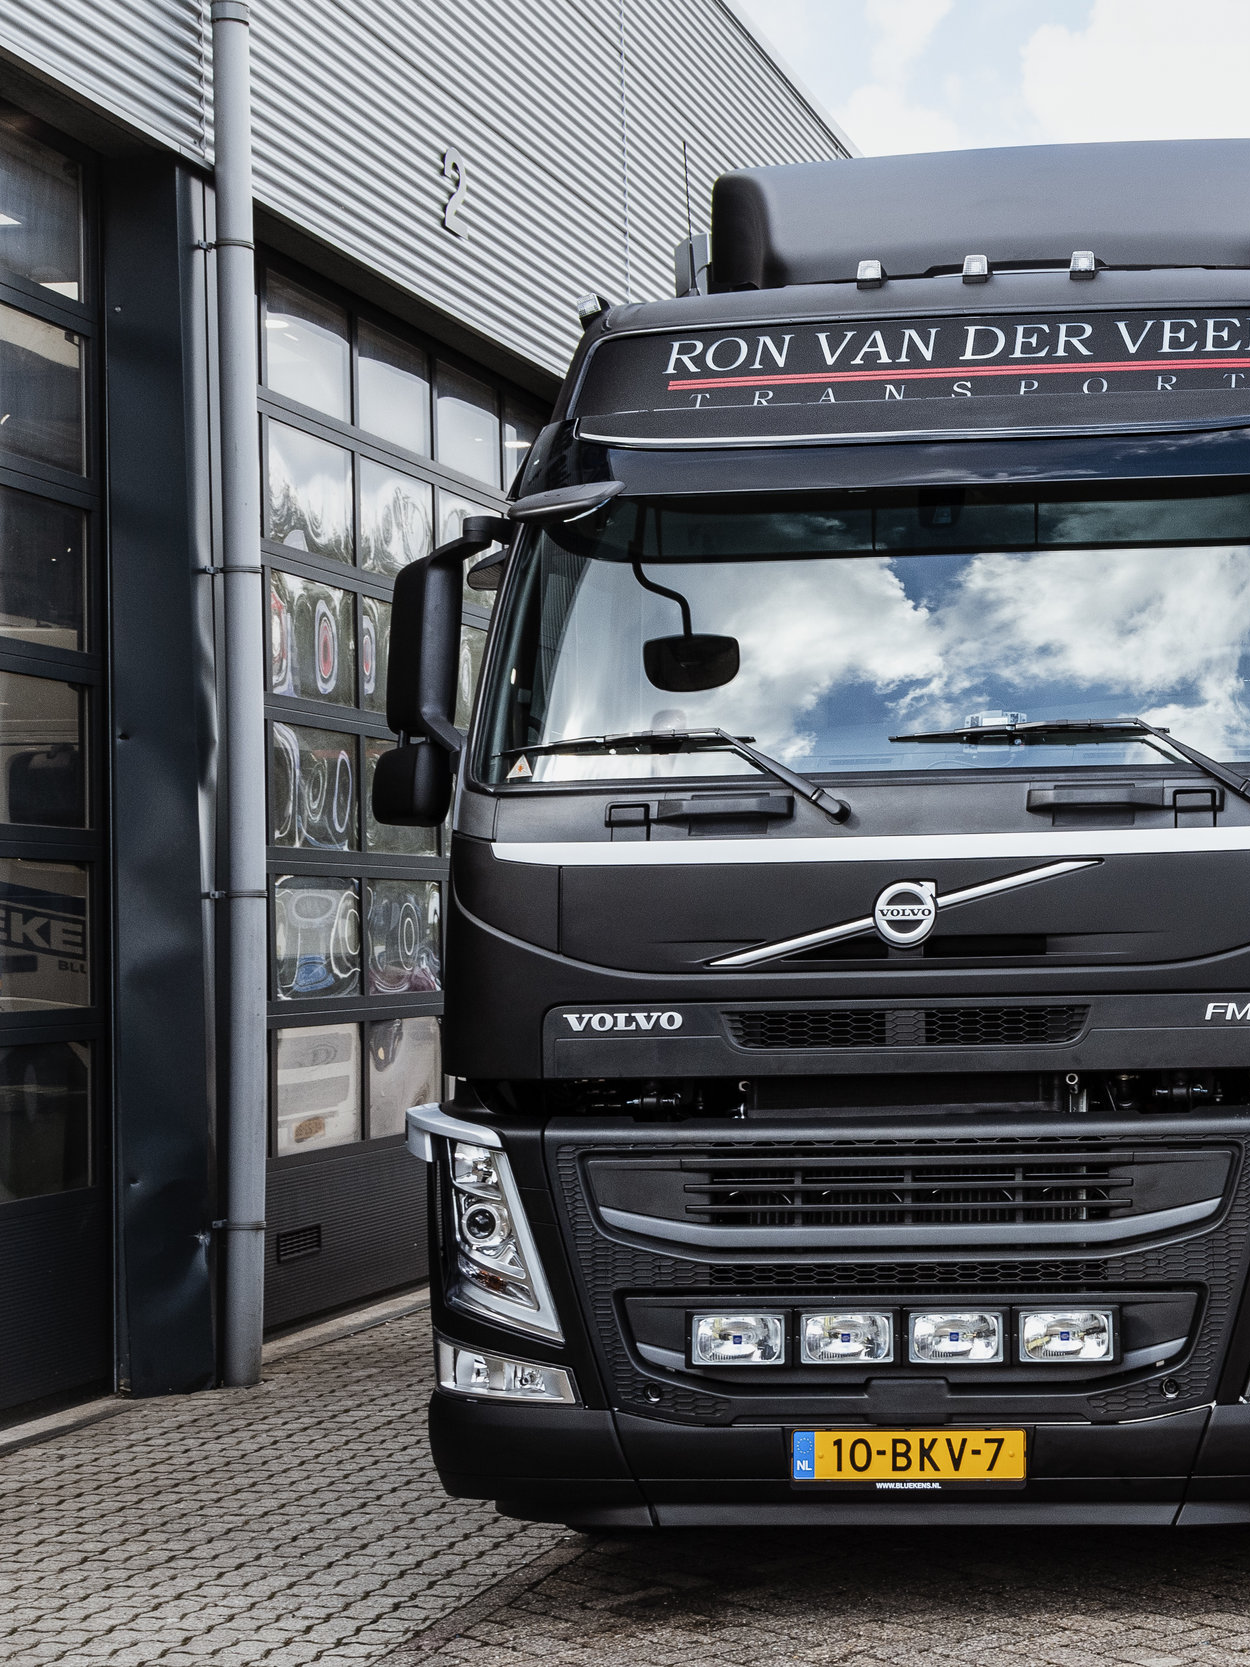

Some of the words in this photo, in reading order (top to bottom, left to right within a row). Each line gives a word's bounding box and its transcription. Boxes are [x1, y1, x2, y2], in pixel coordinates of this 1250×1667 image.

[443, 146, 469, 240] 2
[662, 334, 795, 375] RON
[815, 328, 938, 366] VAN
[959, 322, 1094, 360] DER
[689, 373, 1245, 409] TRANSPORT
[879, 908, 932, 917] VOLVO
[562, 1011, 683, 1032] VOLVO
[796, 1460, 812, 1471] NL
[832, 1437, 1005, 1472] 10-BKV-7
[875, 1482, 942, 1490] WWW.BLUEKENS.NL
